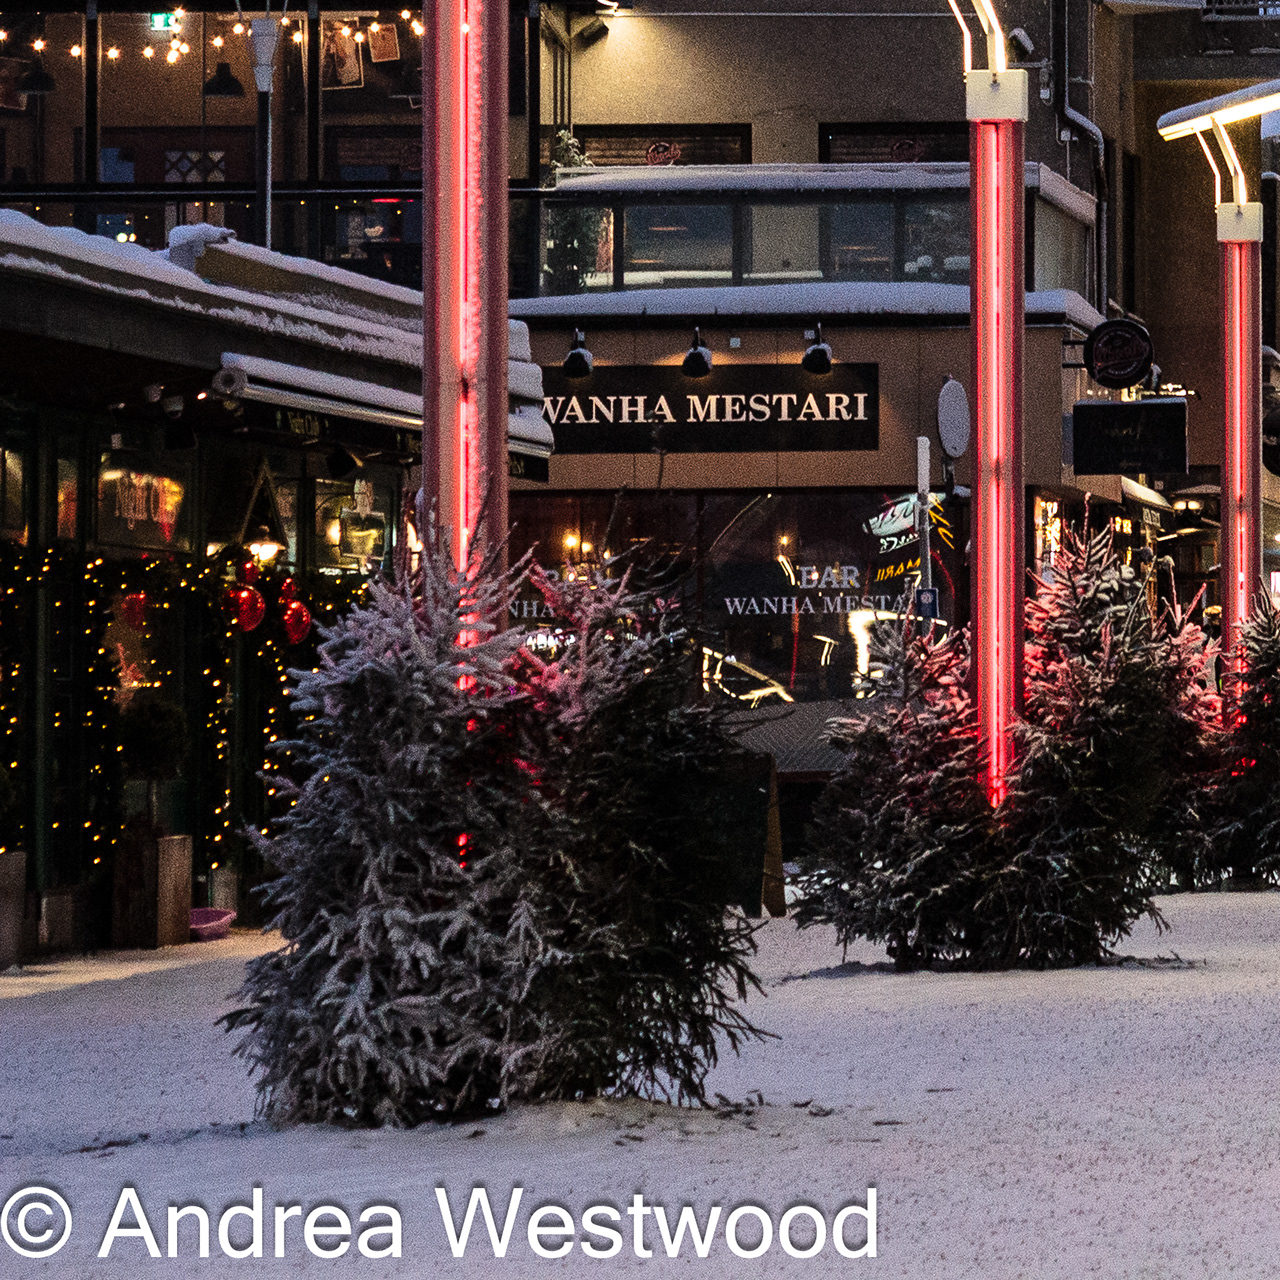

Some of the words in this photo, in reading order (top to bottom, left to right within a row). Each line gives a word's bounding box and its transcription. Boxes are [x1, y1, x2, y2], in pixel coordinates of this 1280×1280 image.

[540, 396, 676, 423] WANHA
[687, 393, 867, 422] MESTARI
[799, 566, 860, 589] BAR
[724, 596, 815, 616] WANHA
